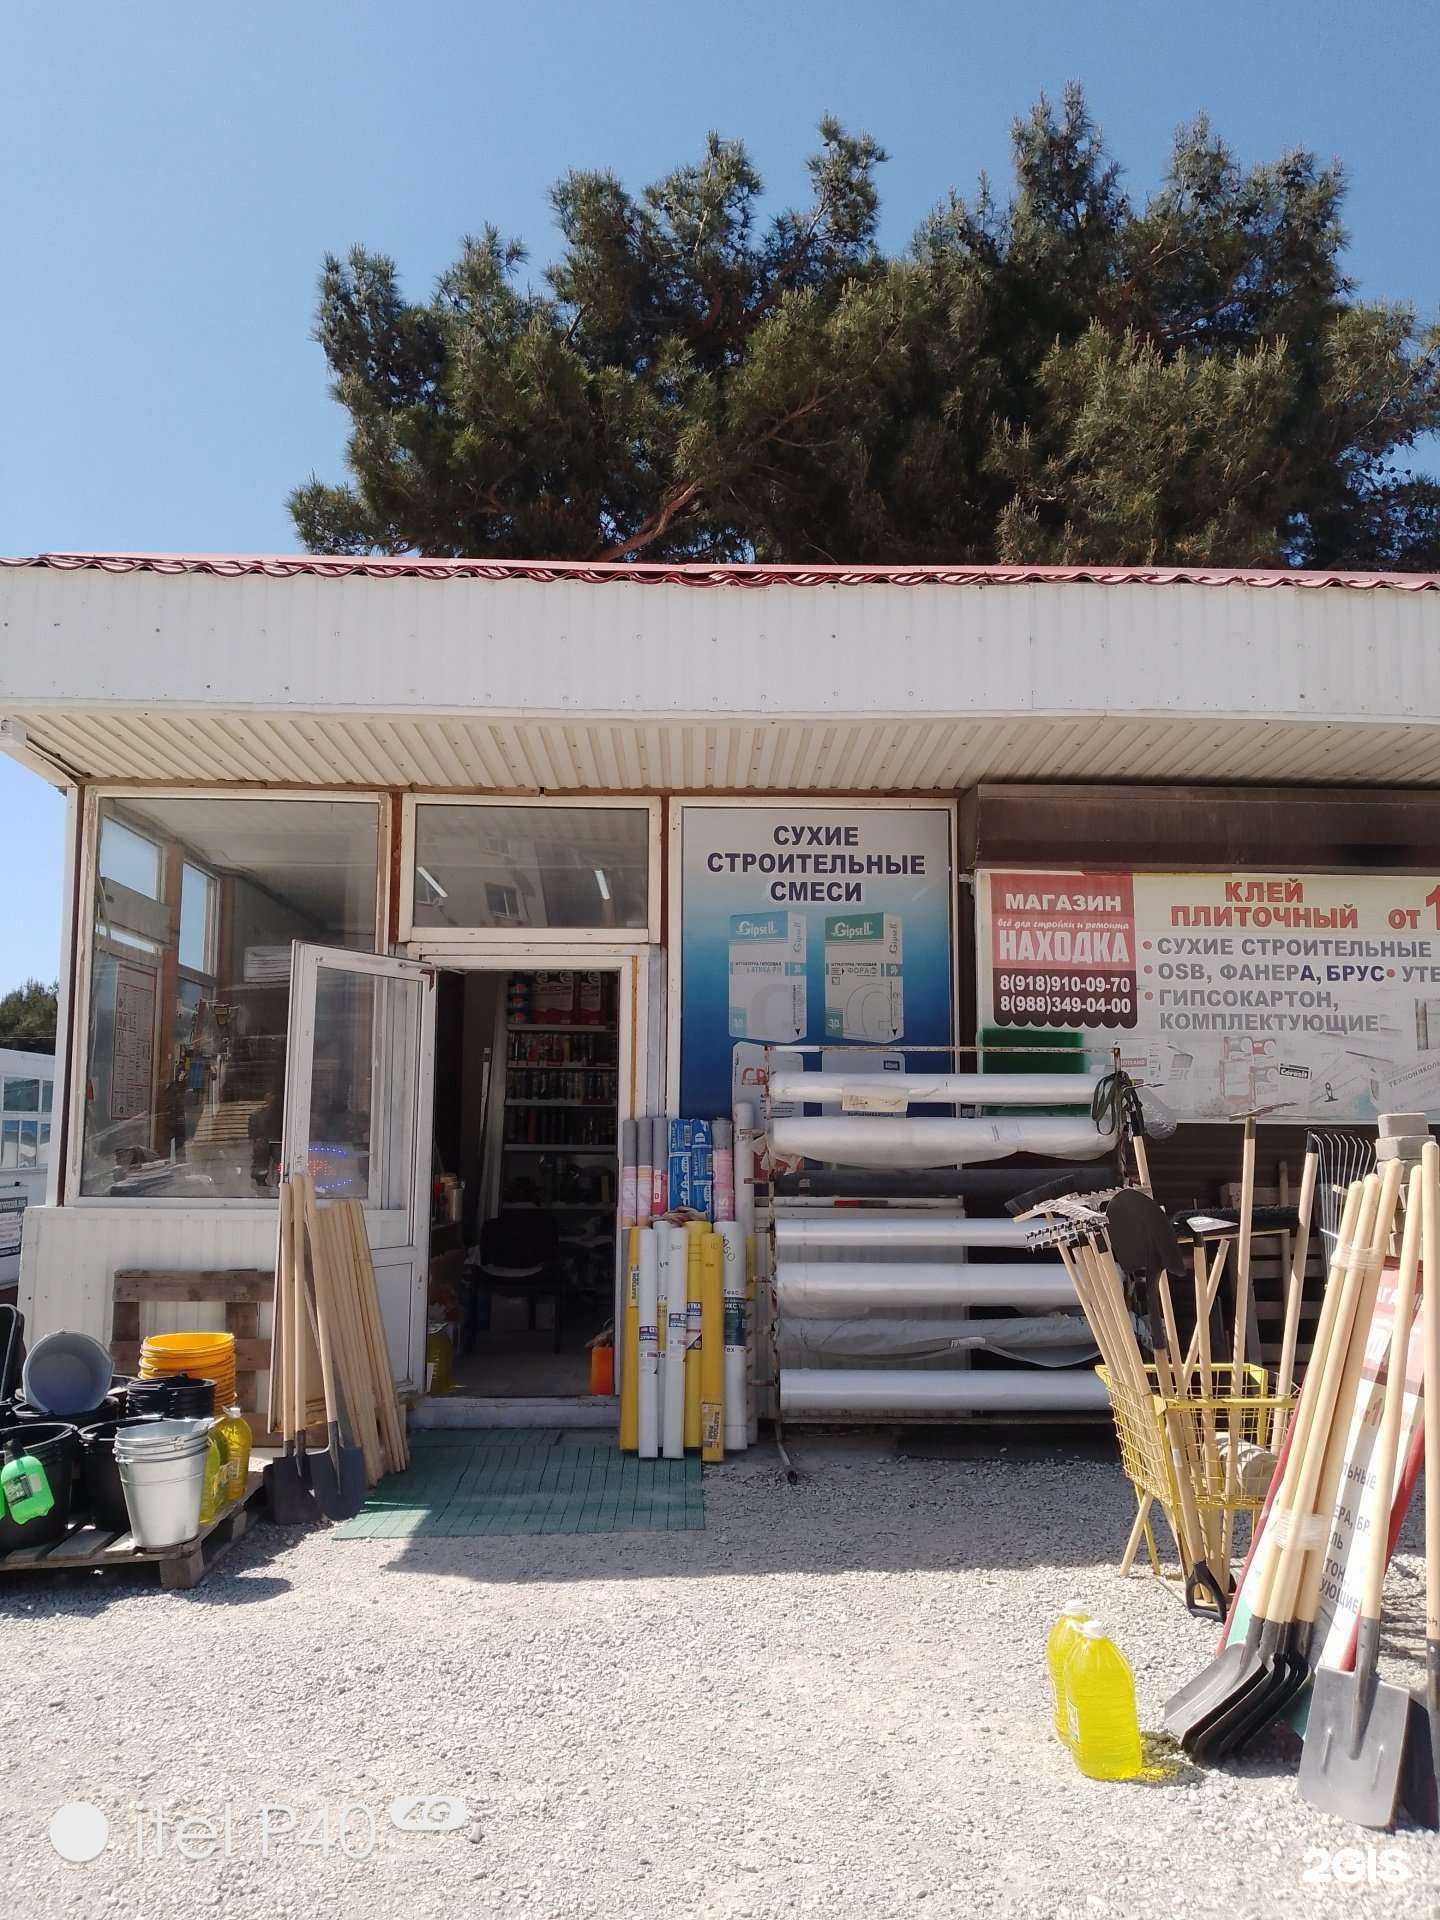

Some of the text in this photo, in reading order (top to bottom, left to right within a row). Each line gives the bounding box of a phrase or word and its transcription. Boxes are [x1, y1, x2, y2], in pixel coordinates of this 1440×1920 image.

[773, 825, 859, 846] СУХИЕ
[707, 852, 926, 875] СТРОИТЕЛЬНЫЕ
[770, 881, 862, 902] СМЕСИ
[1224, 878, 1304, 903] КЛЕЙ
[1005, 893, 1121, 912] МАГАЗИН
[1170, 904, 1359, 929] ПЛИТОЧНЫЙ
[999, 930, 1130, 964] НАХОДКА
[1157, 937, 1432, 958] СУХИЕ СТРОИТЕЛЬНЫЕ
[1000, 974, 1131, 994] 8(918)910-09-70
[1158, 962, 1213, 984] OSB,
[1220, 963, 1322, 985] ФАНЕРА,
[1326, 965, 1385, 982] БРУС
[1000, 995, 1131, 1014] 8(988)349-04-00
[1159, 989, 1338, 1011] ГИПСОКАРТОН,
[1160, 1012, 1379, 1035] КОМПЛЕКТУЮЩИЕ
